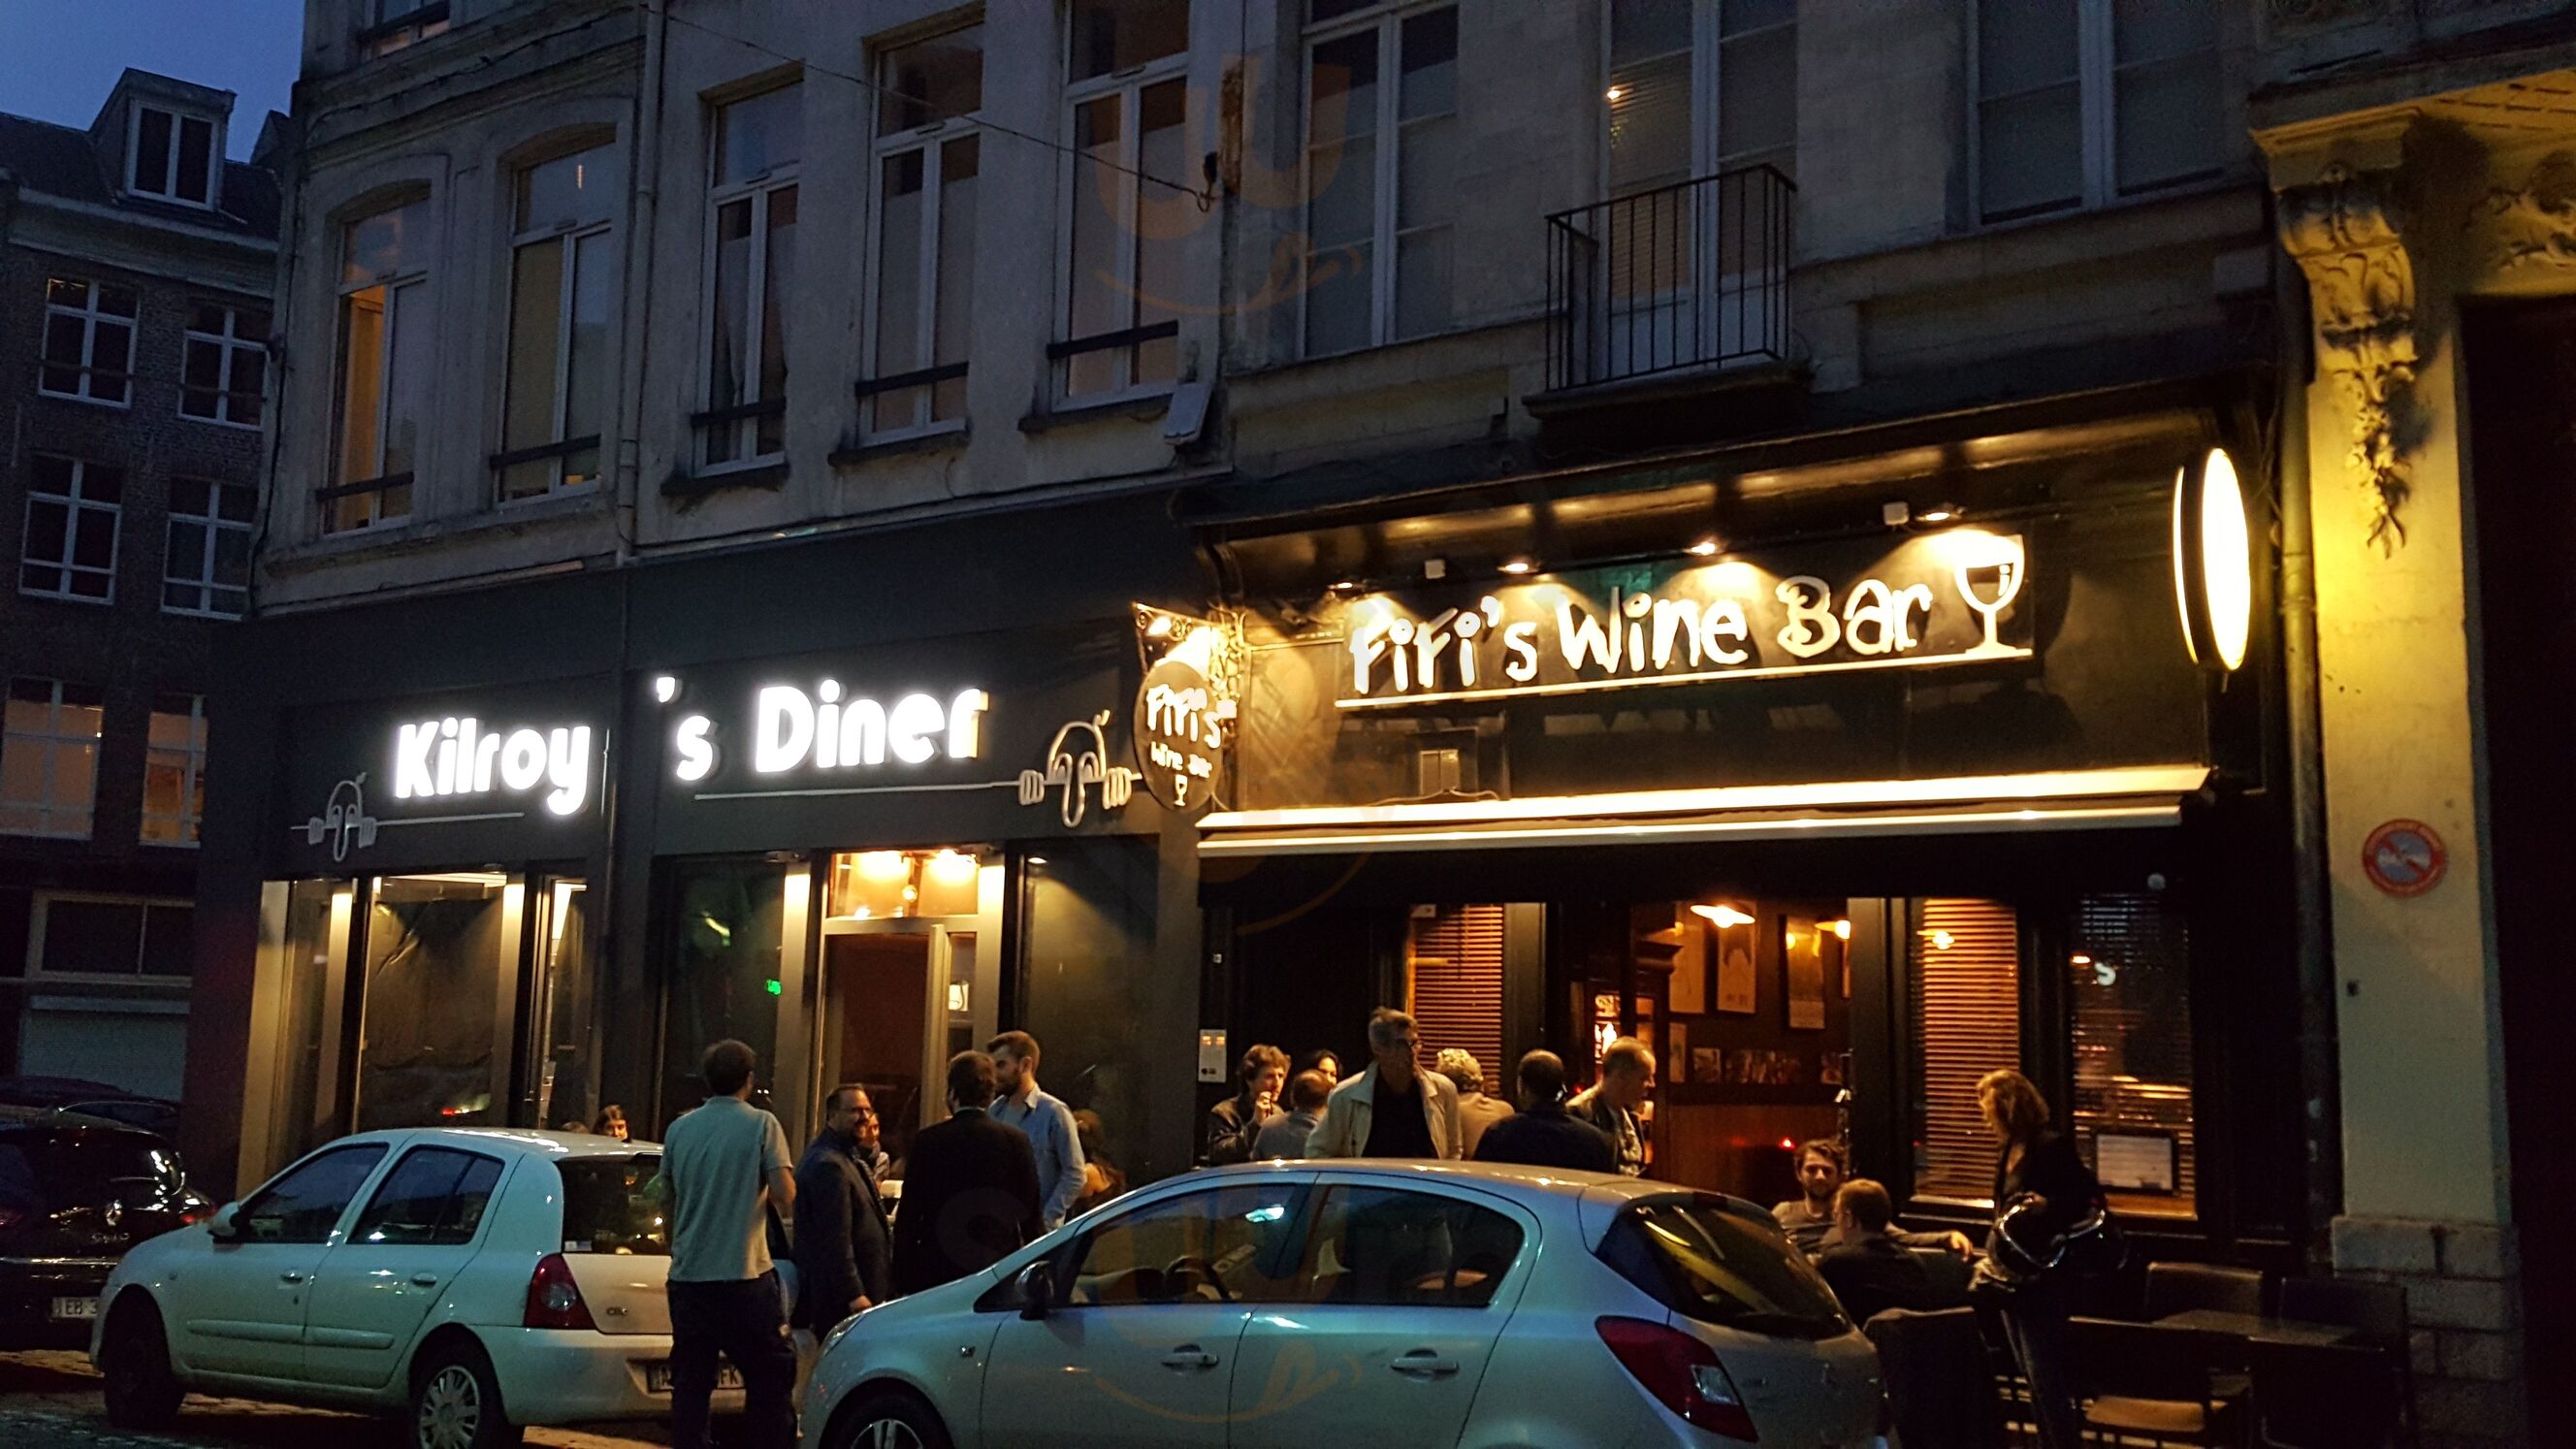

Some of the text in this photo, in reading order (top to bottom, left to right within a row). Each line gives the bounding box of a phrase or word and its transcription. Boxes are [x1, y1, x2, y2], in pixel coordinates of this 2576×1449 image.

[1554, 586, 1748, 674] Wine
[1776, 575, 1933, 658] Bar
[395, 716, 591, 816] Kilroy
[756, 678, 989, 773] Diner
